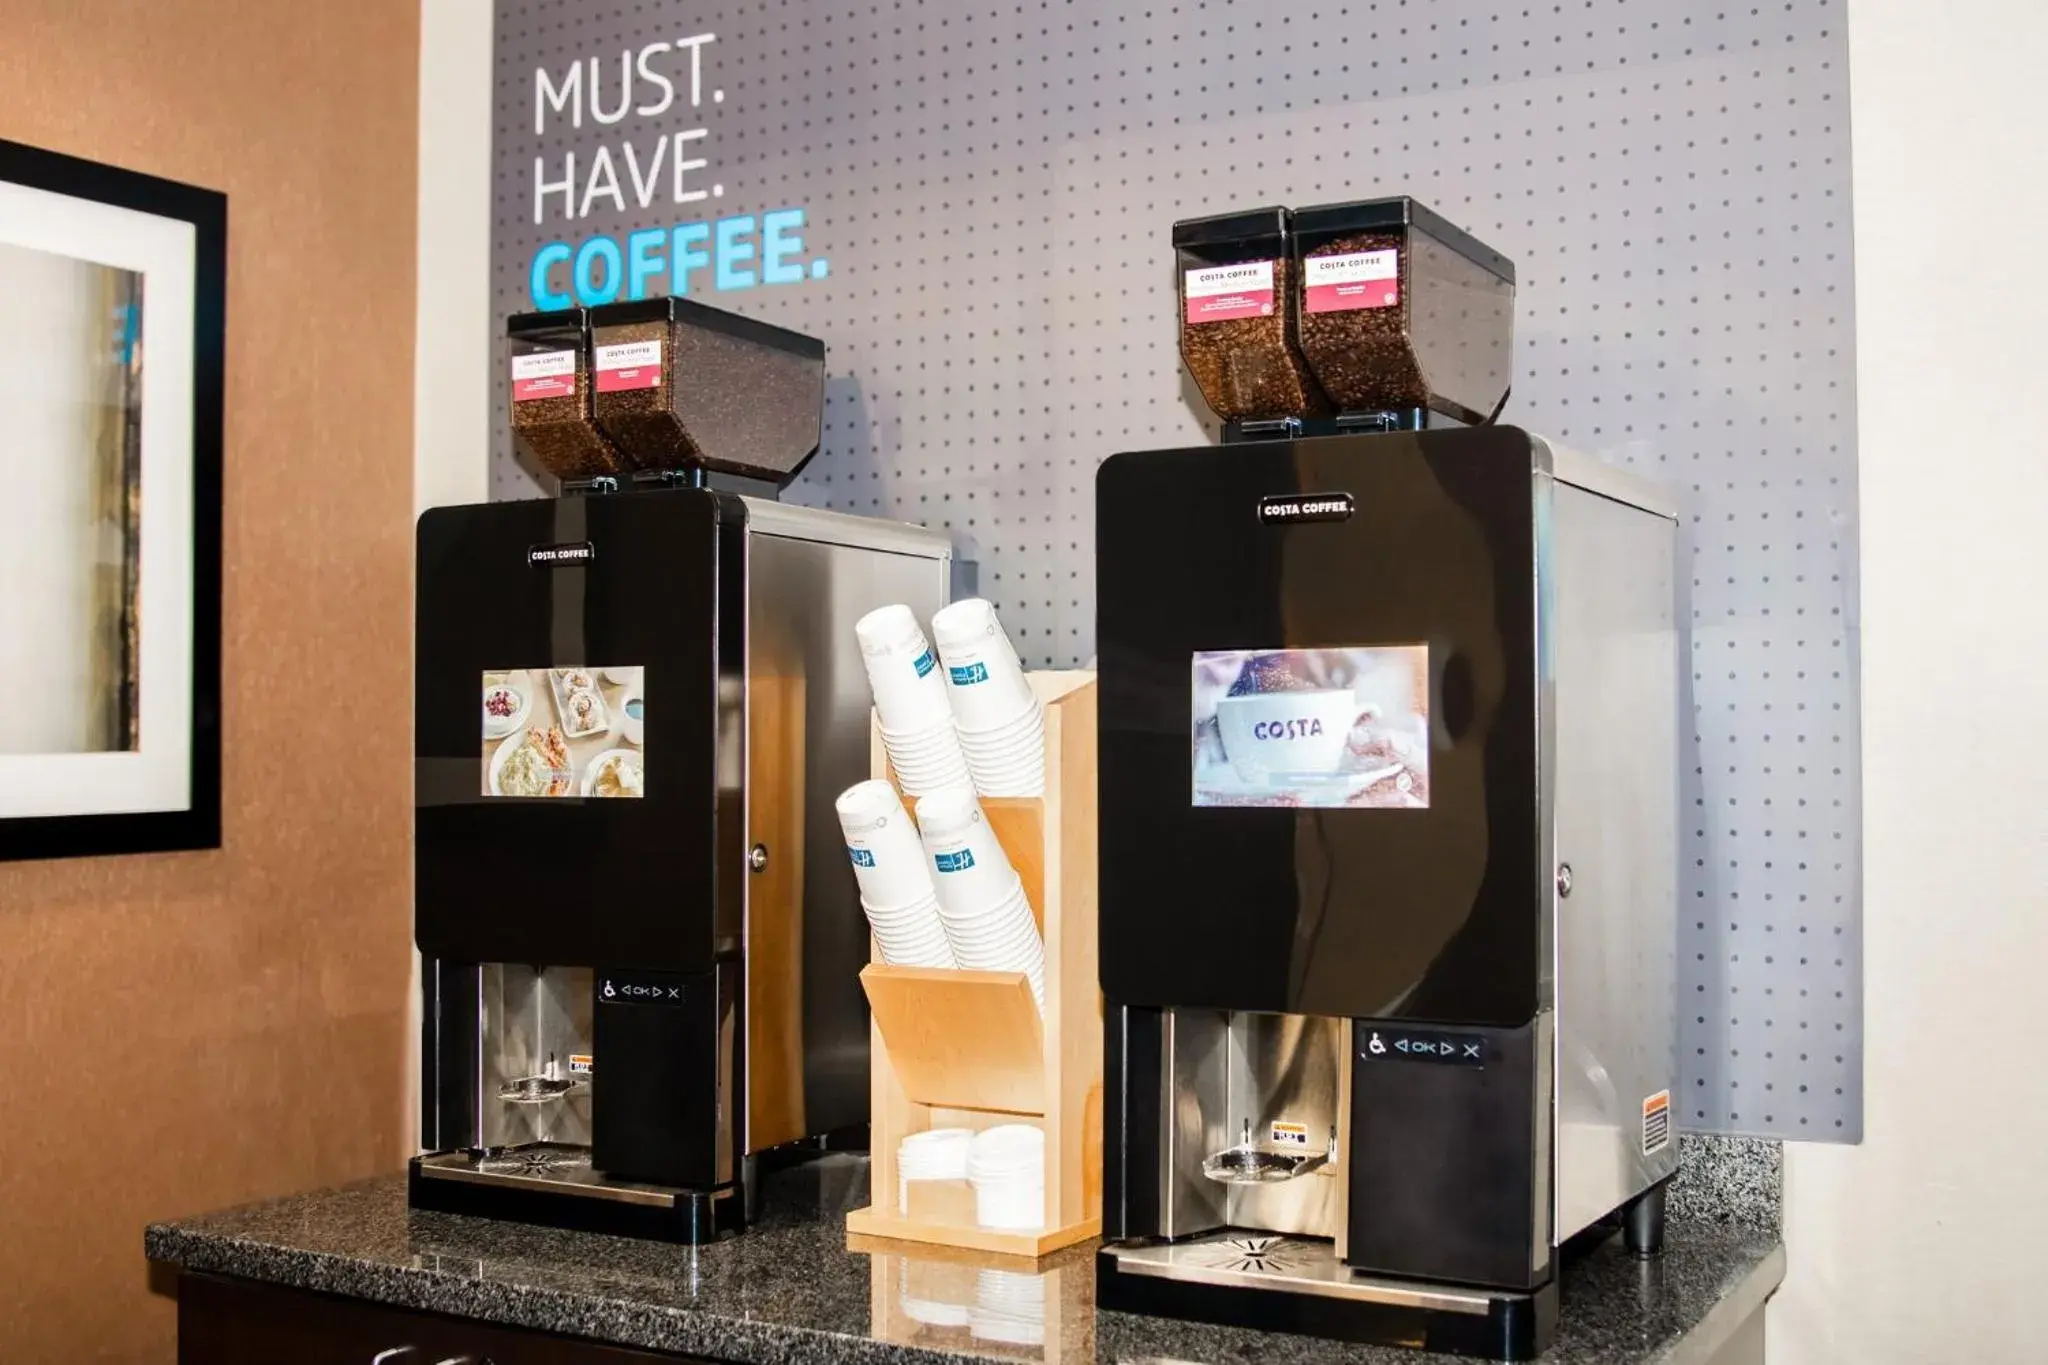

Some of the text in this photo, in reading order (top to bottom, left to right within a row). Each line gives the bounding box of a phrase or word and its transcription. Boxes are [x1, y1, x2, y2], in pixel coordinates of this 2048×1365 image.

[534, 32, 725, 136] MUST.
[534, 127, 724, 225] HAVE.
[529, 208, 829, 313] COFFEE.
[1320, 257, 1381, 270] COSTA COFFEE
[1199, 269, 1258, 282] COSTA COFFEE
[1264, 501, 1347, 516] COSTA COFFEE
[531, 549, 589, 560] COSTA COFFEE
[1254, 718, 1325, 740] COSTA
[633, 986, 651, 996] OK
[1412, 1041, 1437, 1054] OK
